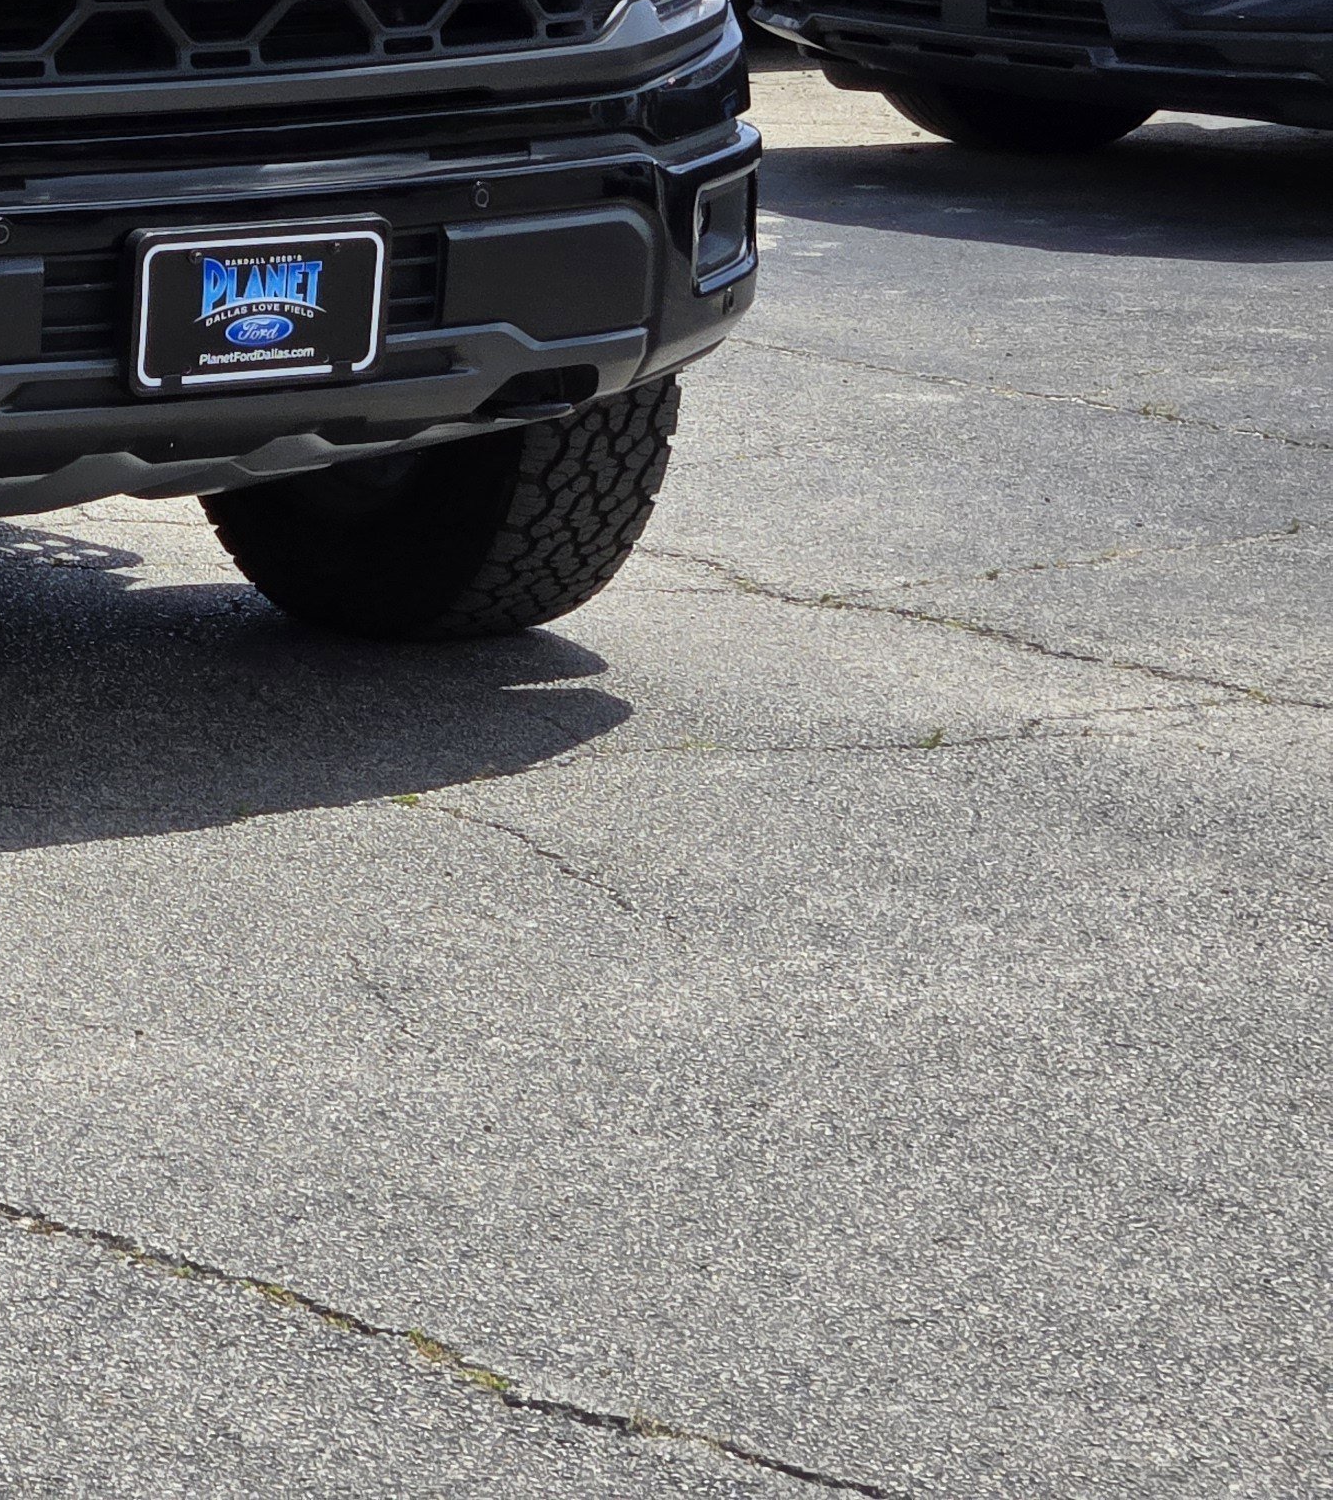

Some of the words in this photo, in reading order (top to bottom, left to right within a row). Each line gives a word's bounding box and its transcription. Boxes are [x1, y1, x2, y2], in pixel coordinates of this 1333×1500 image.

[200, 257, 323, 318] PLANET
[205, 305, 249, 328] DALLAS
[251, 302, 281, 313] LOVE
[283, 305, 315, 319] FIELD
[237, 319, 279, 341] Ford
[198, 347, 315, 366] PlanetFordDallas.com
